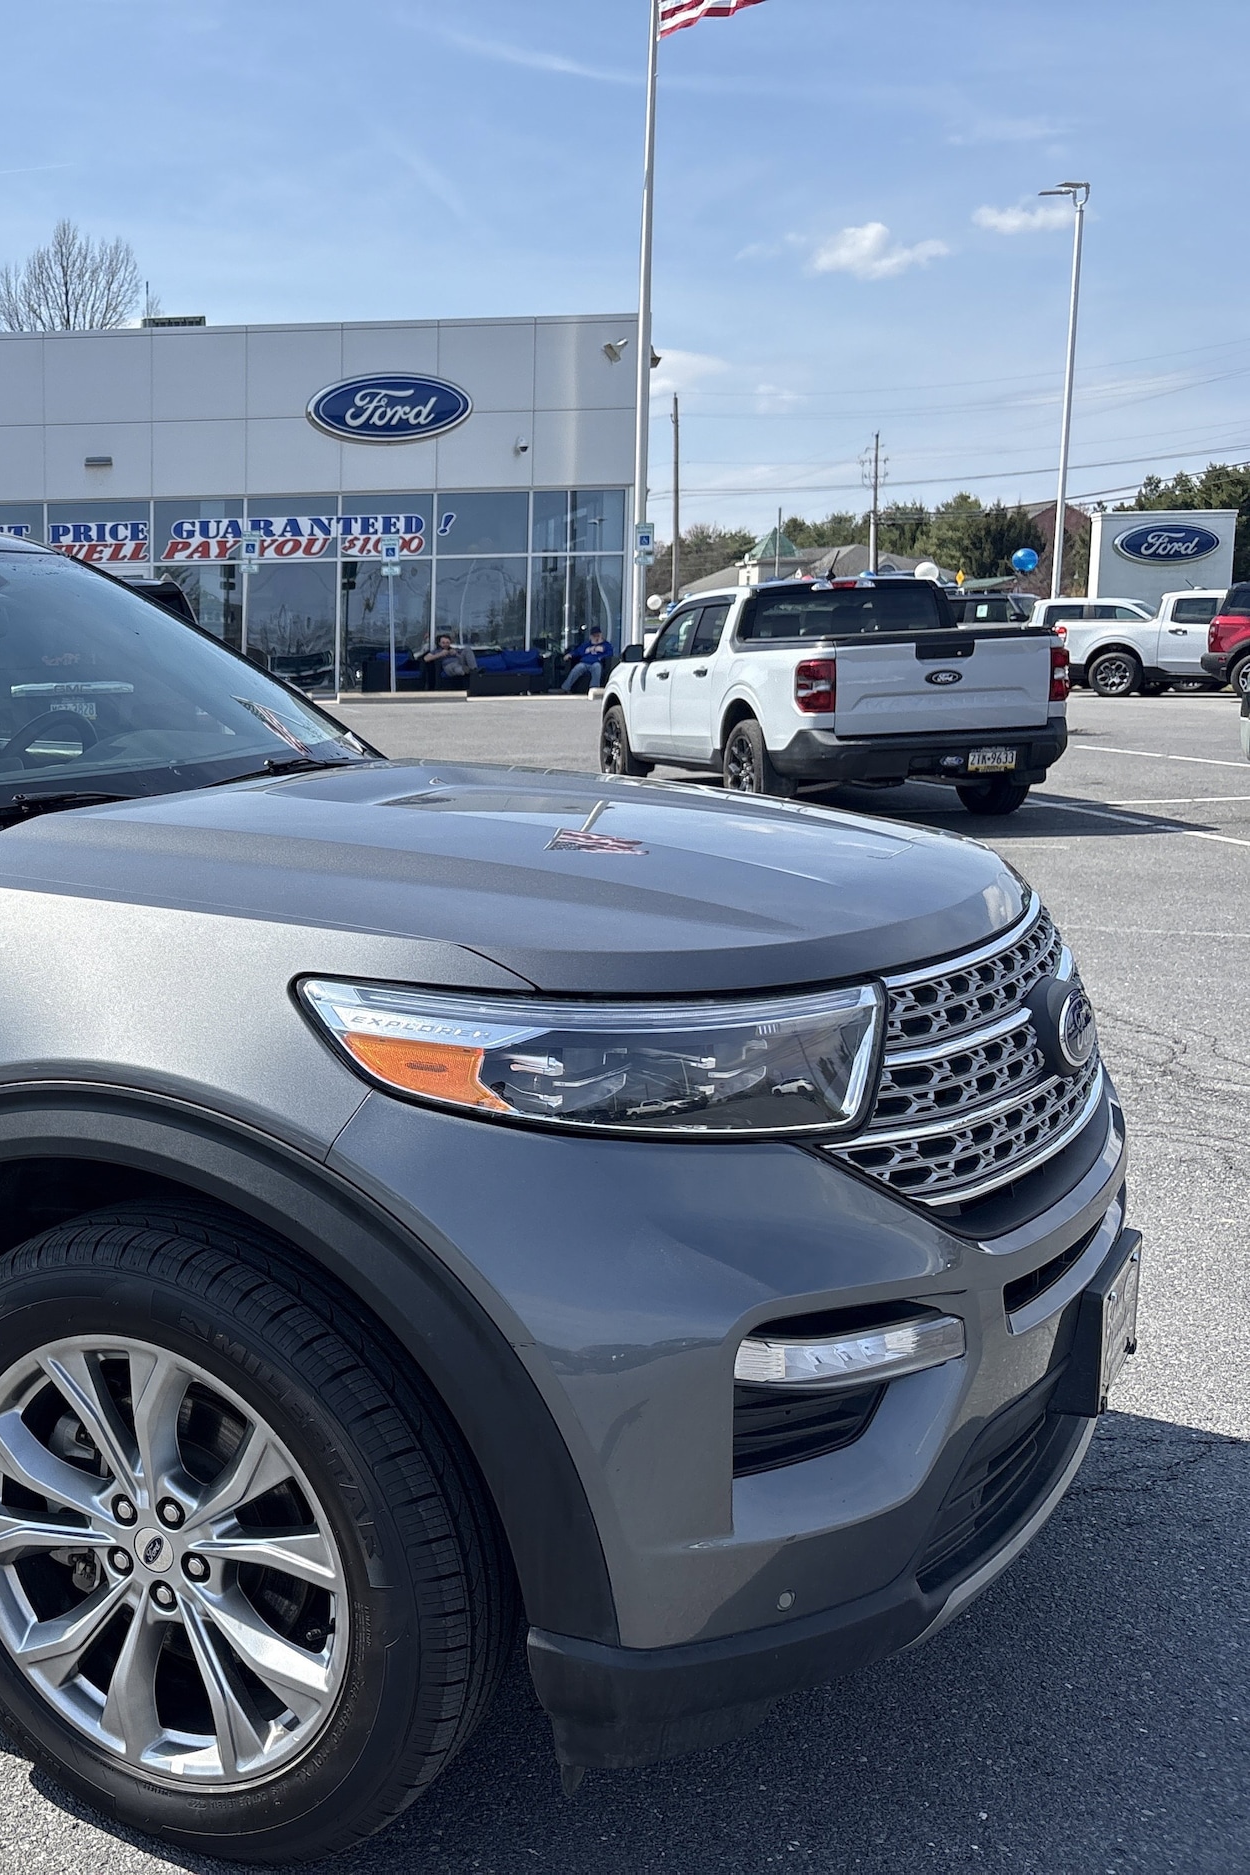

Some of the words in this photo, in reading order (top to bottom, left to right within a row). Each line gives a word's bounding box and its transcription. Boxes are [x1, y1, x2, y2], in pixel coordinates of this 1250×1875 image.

[344, 388, 437, 427] Ford
[49, 522, 148, 544] PRICE
[172, 514, 424, 540] GUARANTEED
[161, 539, 242, 560] PAY
[259, 538, 331, 558] YOU
[341, 535, 424, 556] $1,00
[1140, 531, 1200, 556] Ford
[53, 684, 93, 695] GMC
[351, 1015, 491, 1038] EXPLORER
